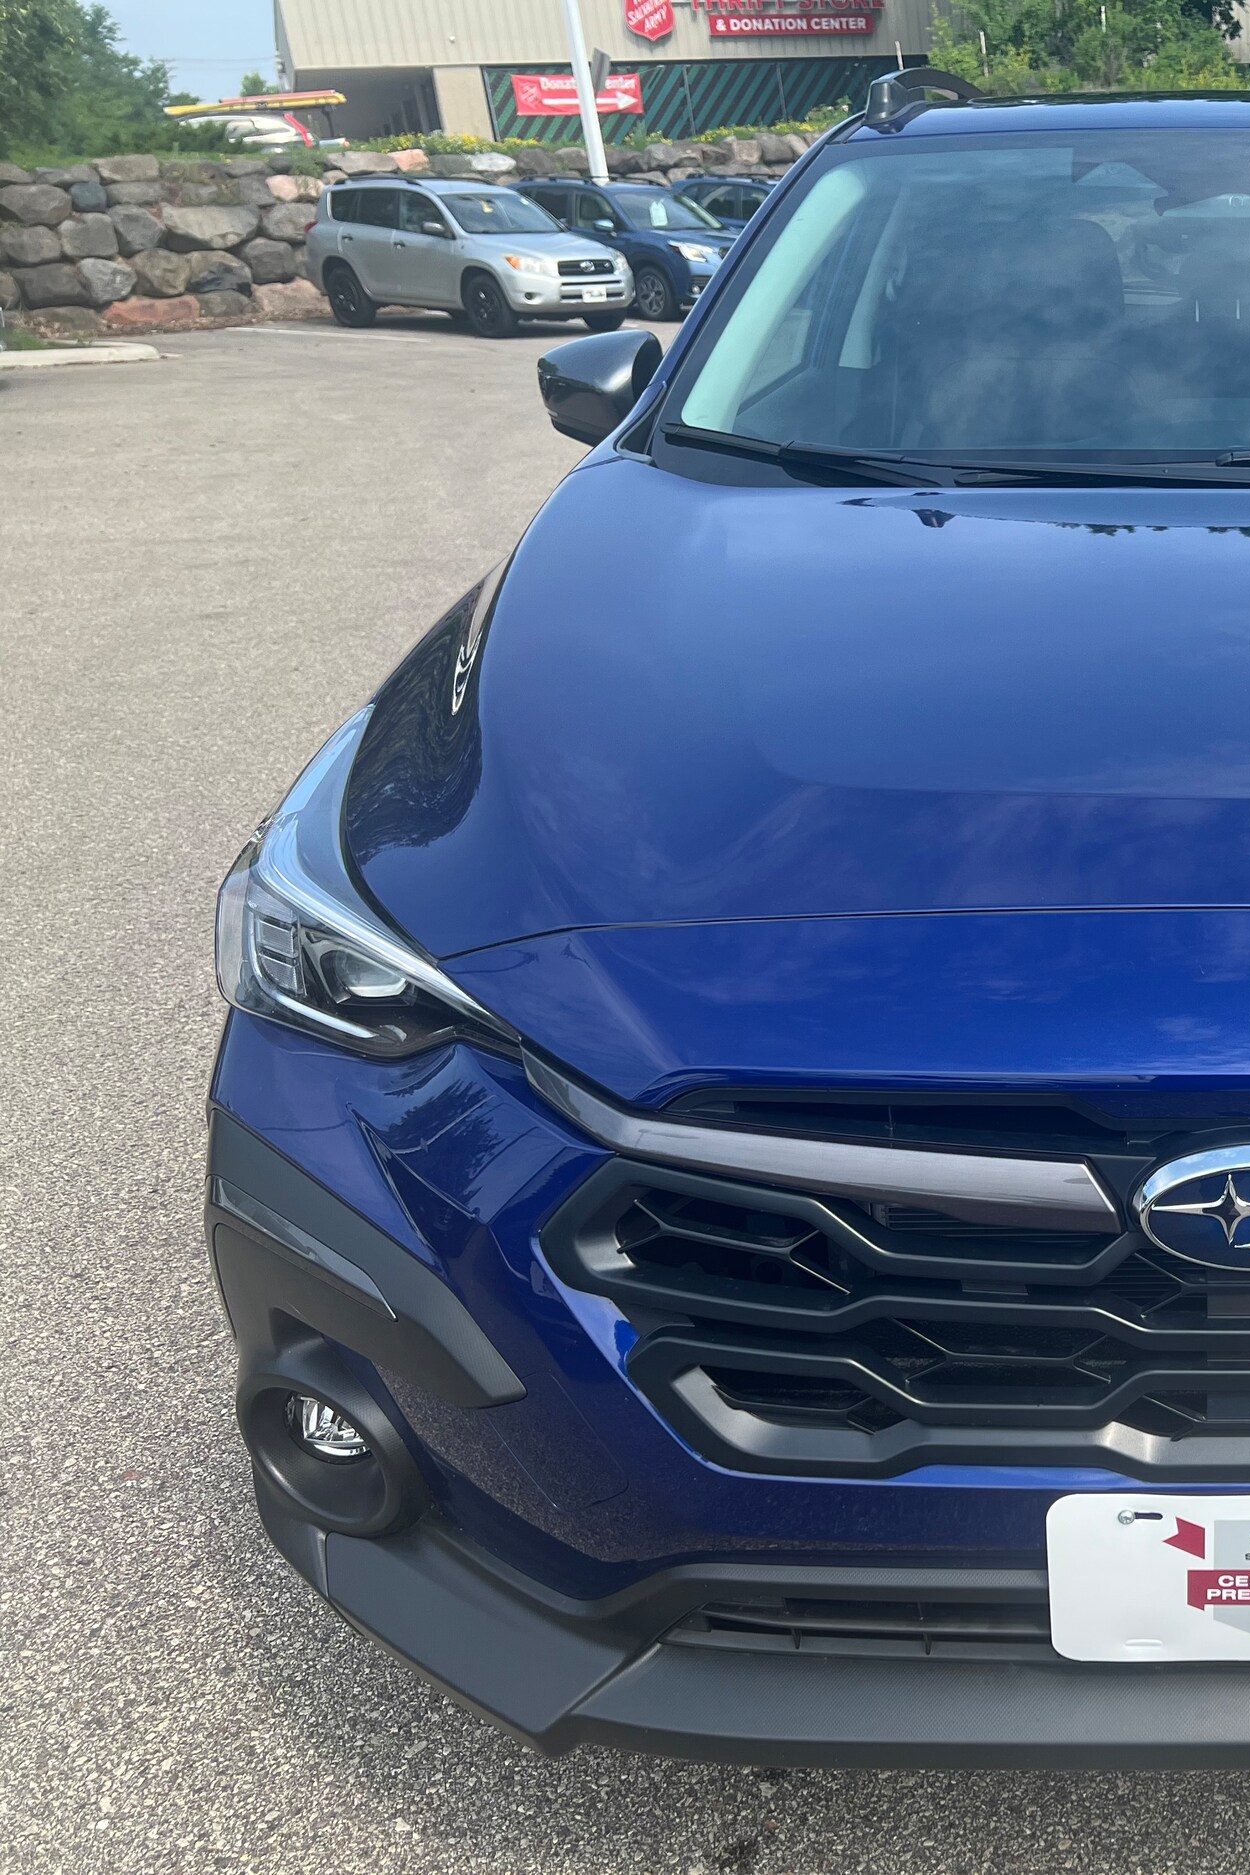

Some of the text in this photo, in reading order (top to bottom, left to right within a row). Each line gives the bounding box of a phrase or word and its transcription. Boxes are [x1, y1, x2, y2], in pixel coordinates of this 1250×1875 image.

[644, 4, 668, 33] ARMY
[715, 17, 867, 31] & DONATION CENTER
[540, 76, 578, 90] Donat
